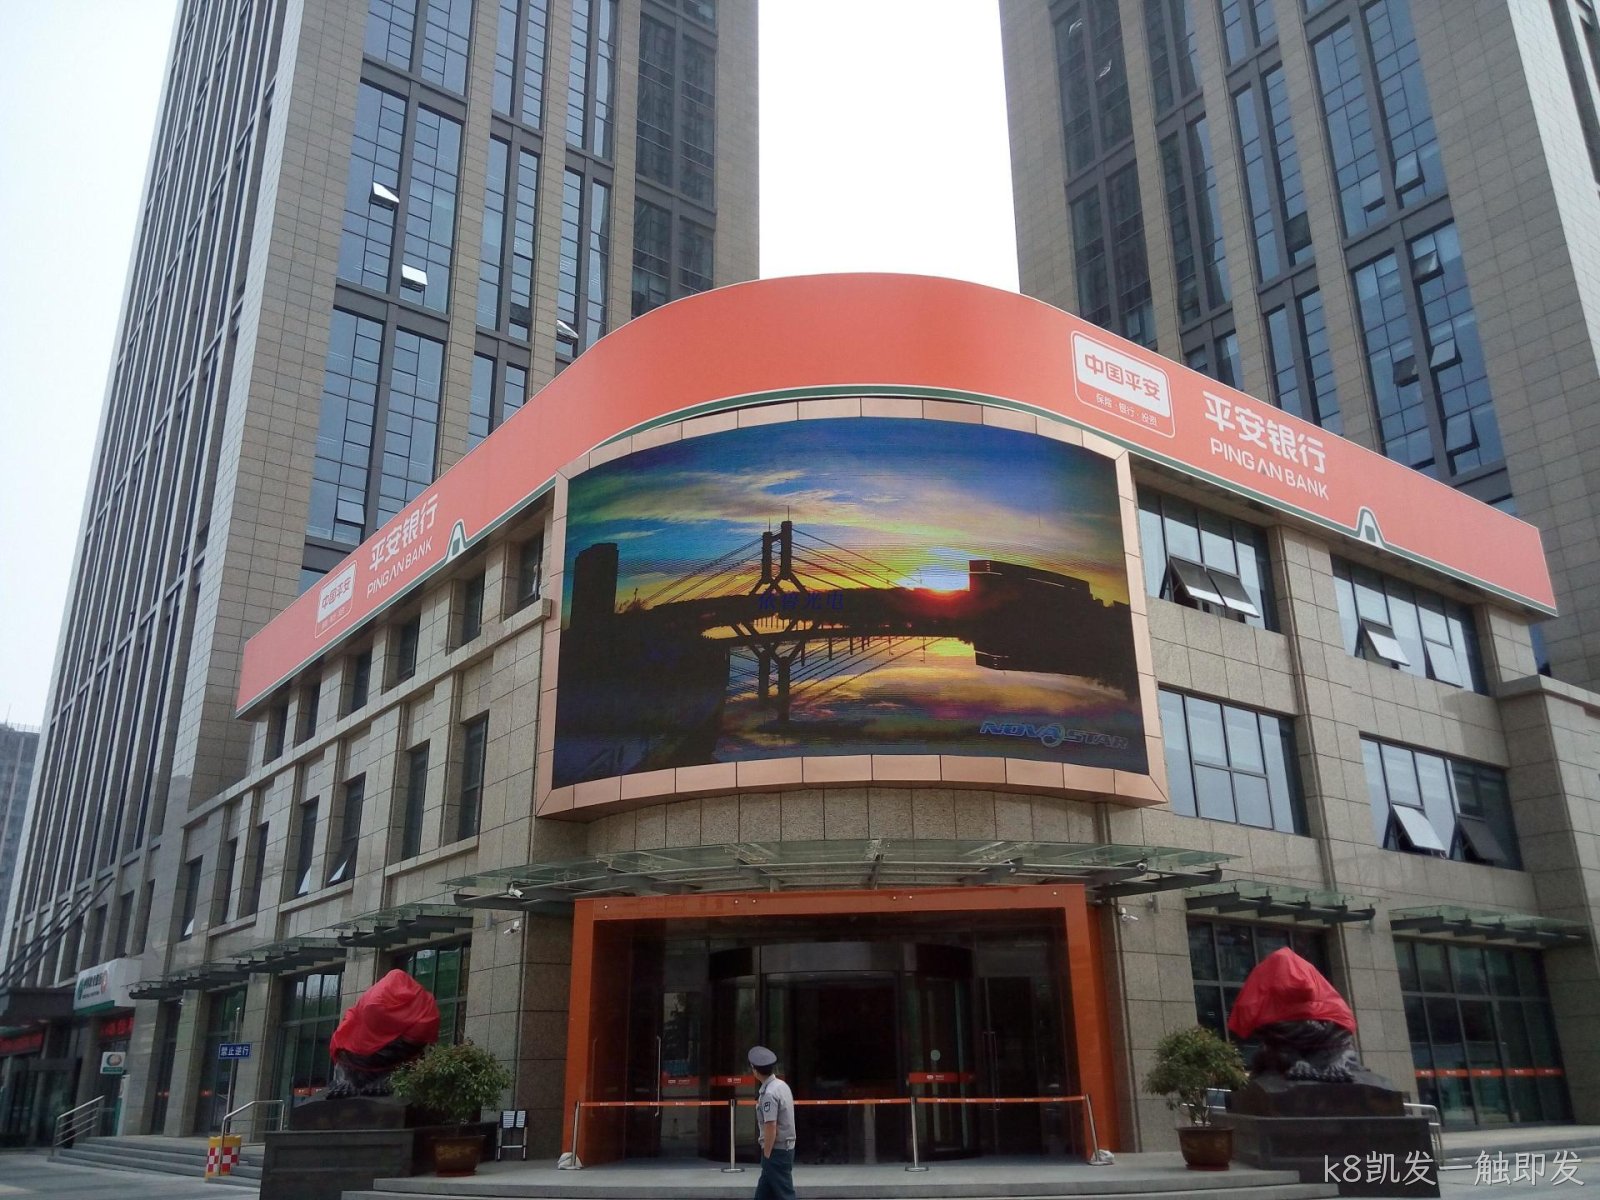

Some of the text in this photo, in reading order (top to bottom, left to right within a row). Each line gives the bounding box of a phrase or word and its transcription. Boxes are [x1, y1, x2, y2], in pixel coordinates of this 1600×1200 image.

[1084, 354, 1161, 401] 中国平安
[1202, 390, 1326, 474] 平安银行
[1286, 468, 1329, 500] BANK
[369, 493, 438, 572] 平安银行
[404, 535, 433, 569] BANK
